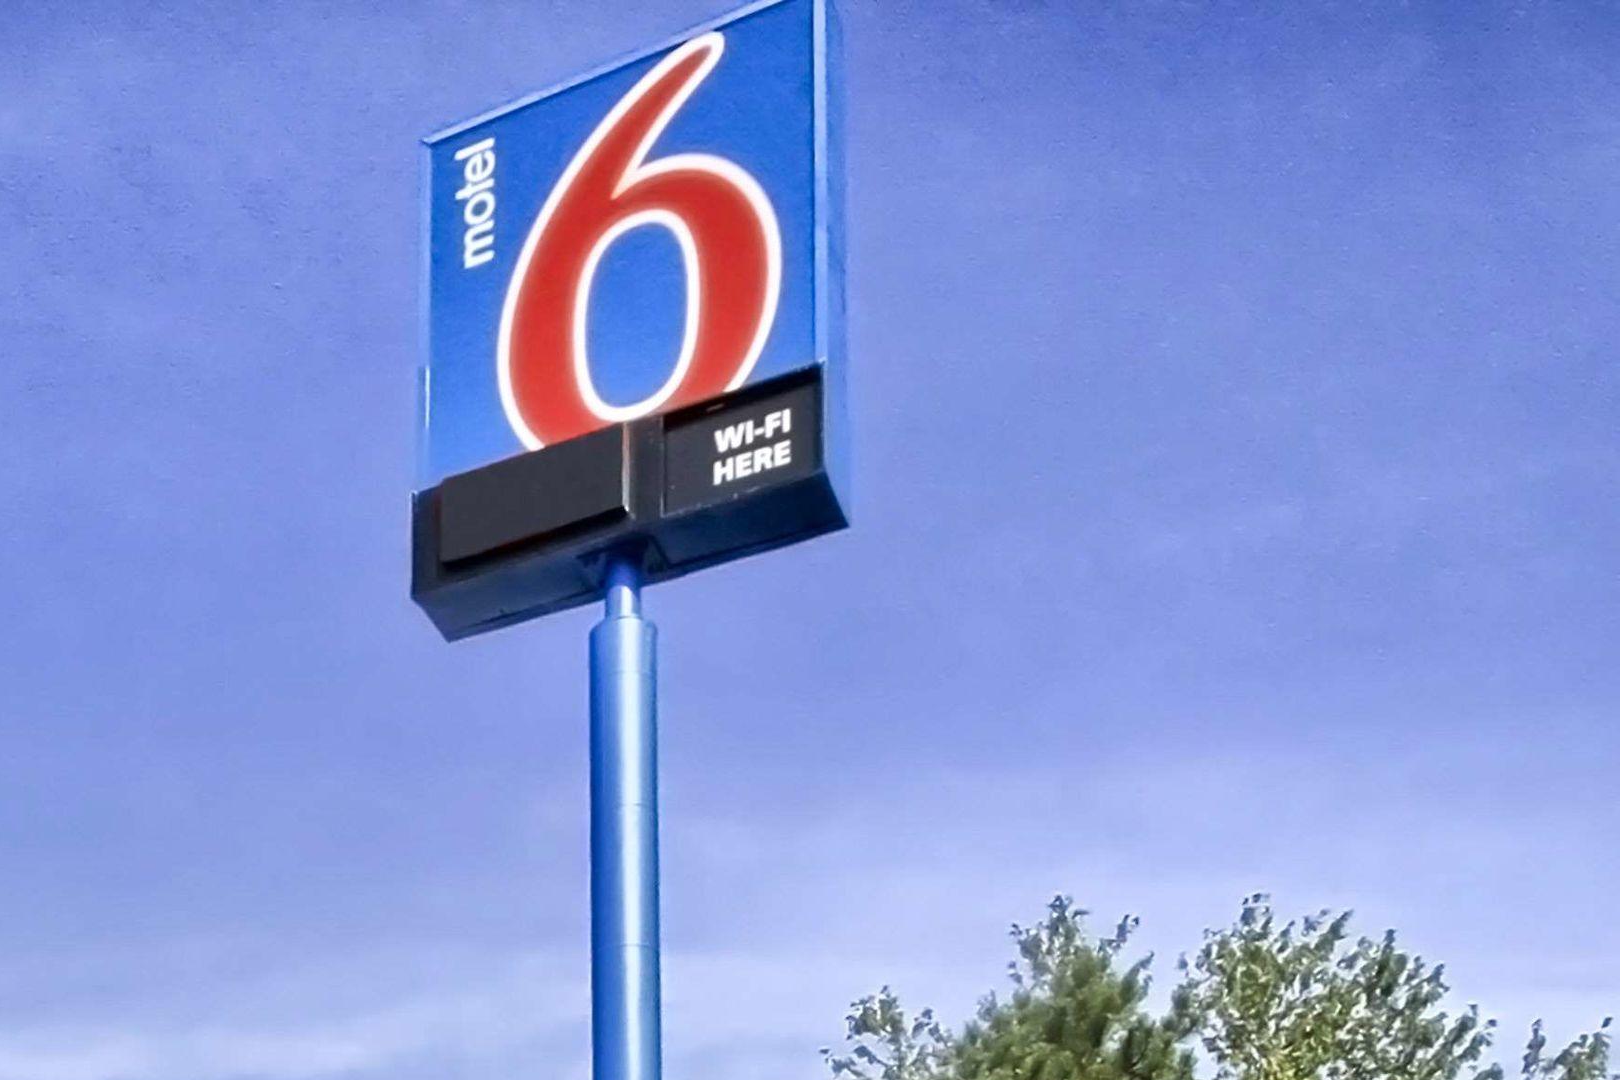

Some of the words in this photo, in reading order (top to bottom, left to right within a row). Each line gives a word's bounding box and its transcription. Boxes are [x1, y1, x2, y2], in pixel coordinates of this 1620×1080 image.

[454, 137, 496, 269] motel
[497, 31, 782, 450] 6
[713, 439, 791, 486] HERE
[714, 408, 791, 453] WI-FI
